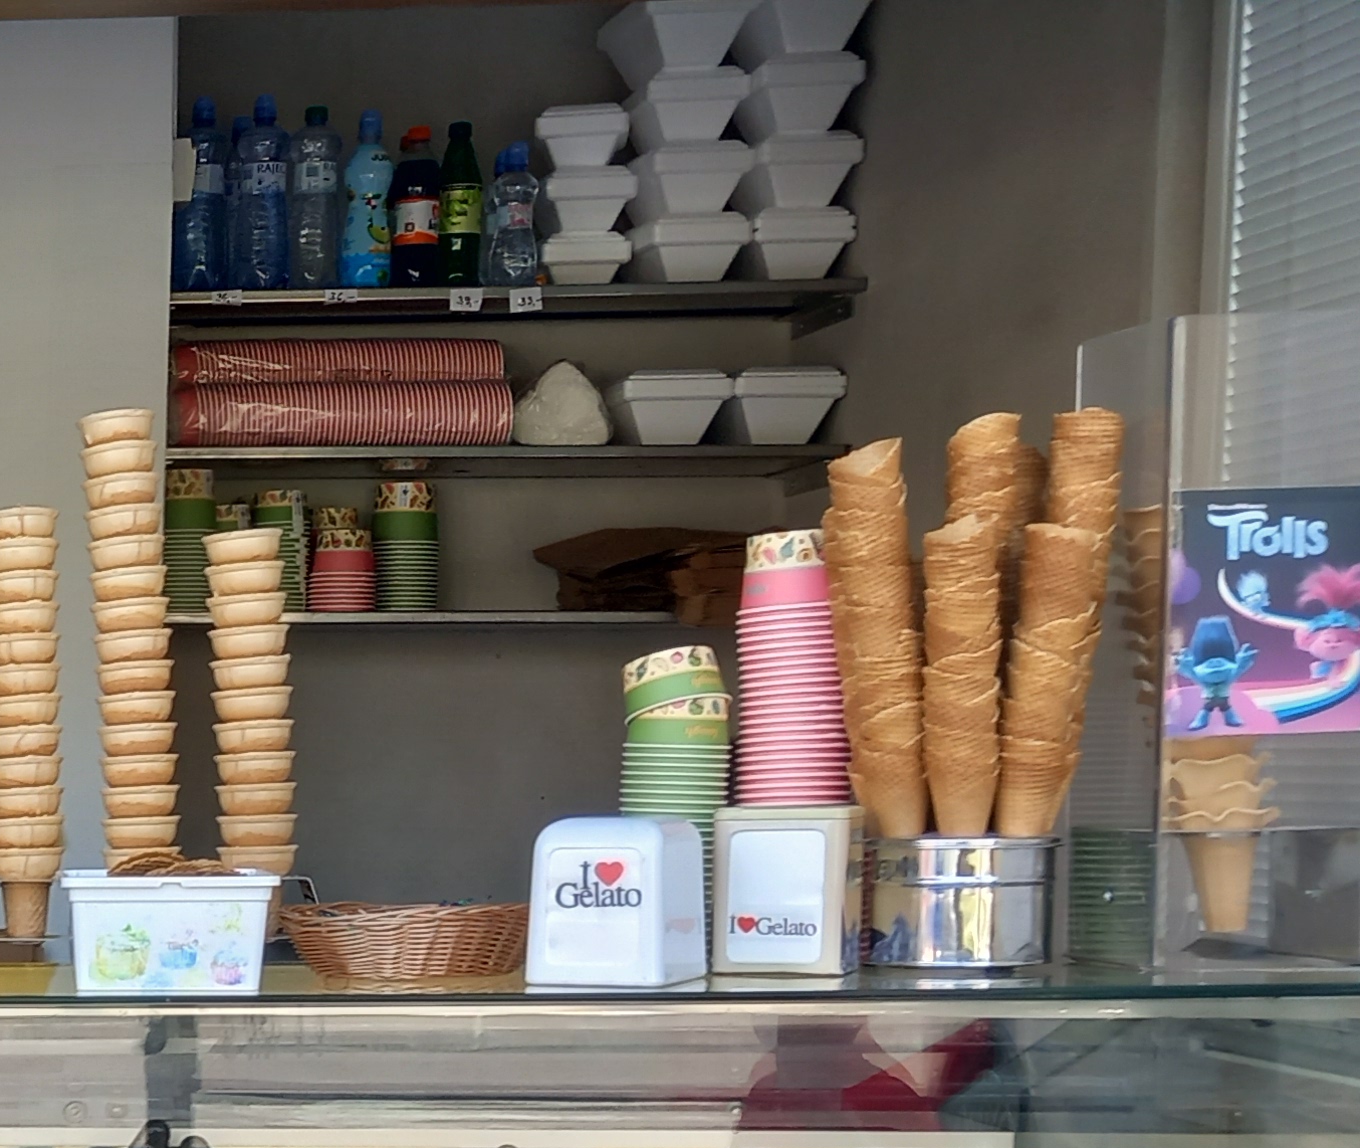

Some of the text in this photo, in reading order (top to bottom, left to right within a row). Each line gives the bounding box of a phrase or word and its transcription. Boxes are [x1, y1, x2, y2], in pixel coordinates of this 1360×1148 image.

[579, 861, 591, 889] I
[555, 882, 642, 909] Gelato
[729, 915, 818, 937] I Gelato
